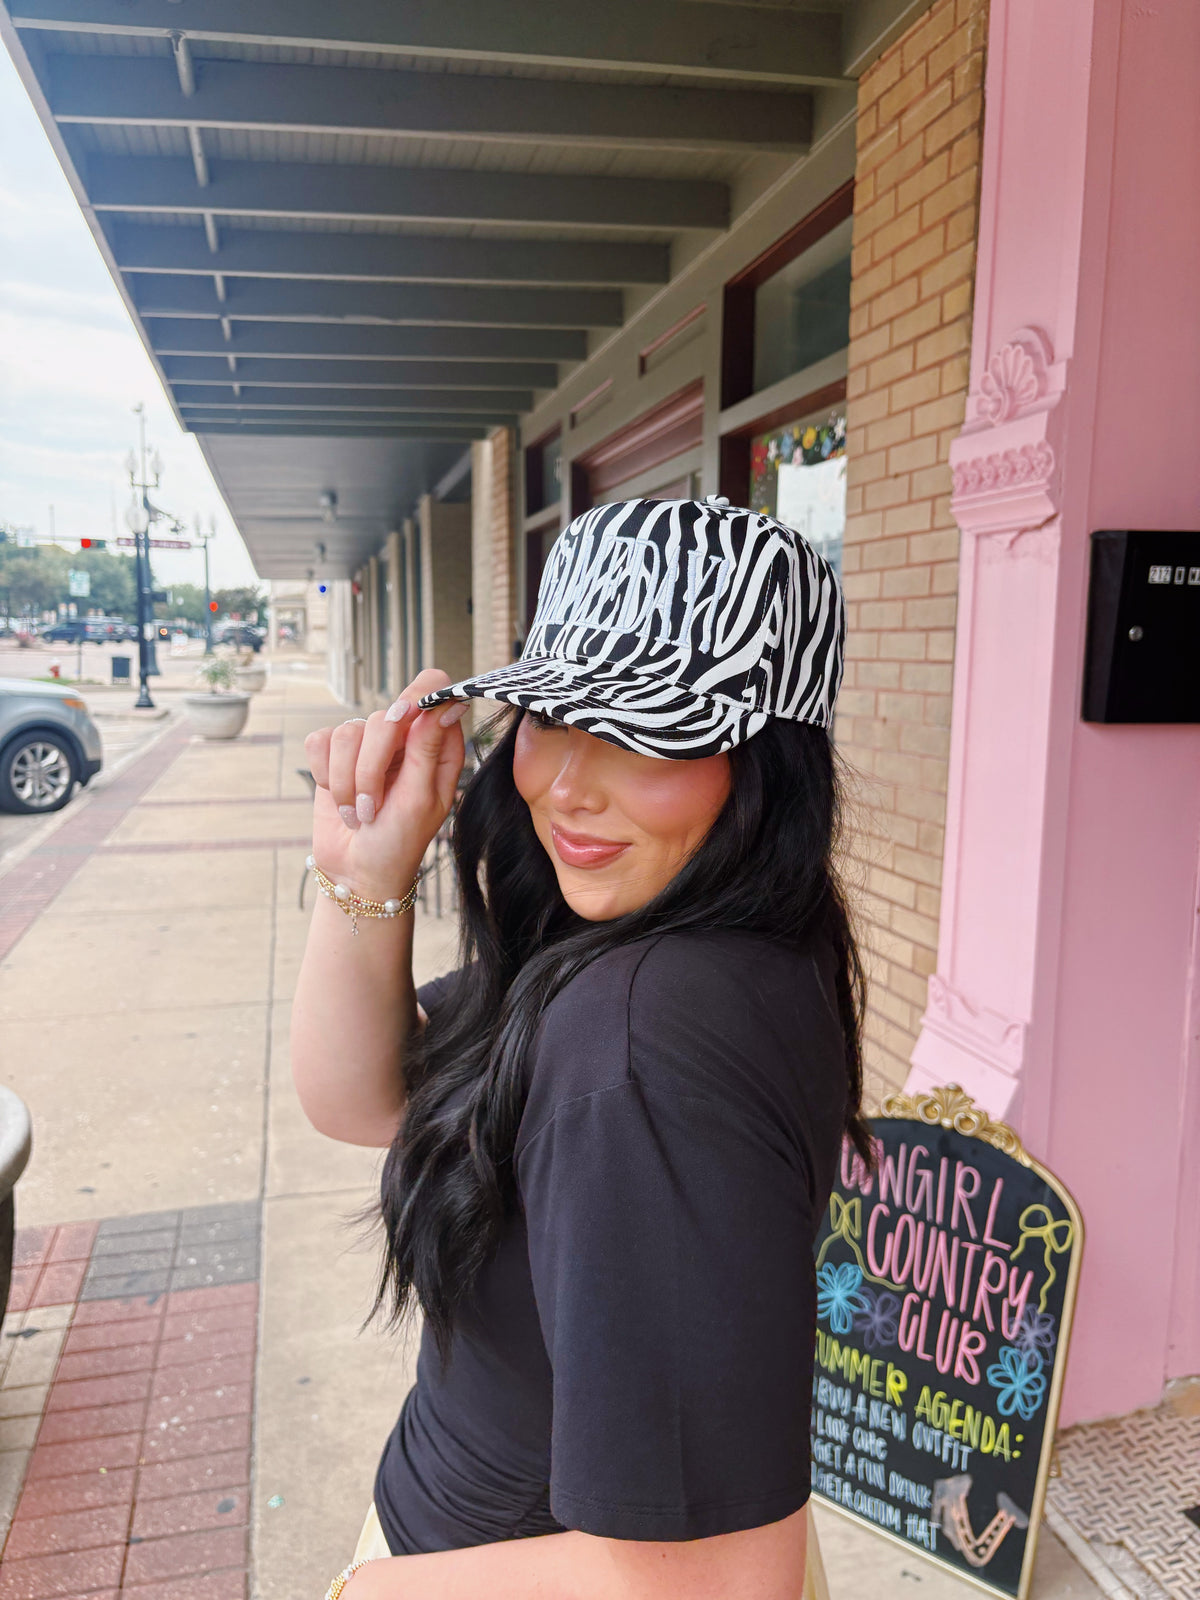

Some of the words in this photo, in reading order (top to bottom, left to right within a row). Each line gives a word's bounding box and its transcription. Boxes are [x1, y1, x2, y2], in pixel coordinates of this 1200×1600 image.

[867, 1203, 1035, 1341] COUNTRY
[898, 1292, 987, 1385] CLUB
[869, 1400, 907, 1442] NEW
[912, 1421, 974, 1472] OUTFIT
[914, 1385, 1025, 1463] AGENDA:
[904, 1512, 942, 1551] HAT
